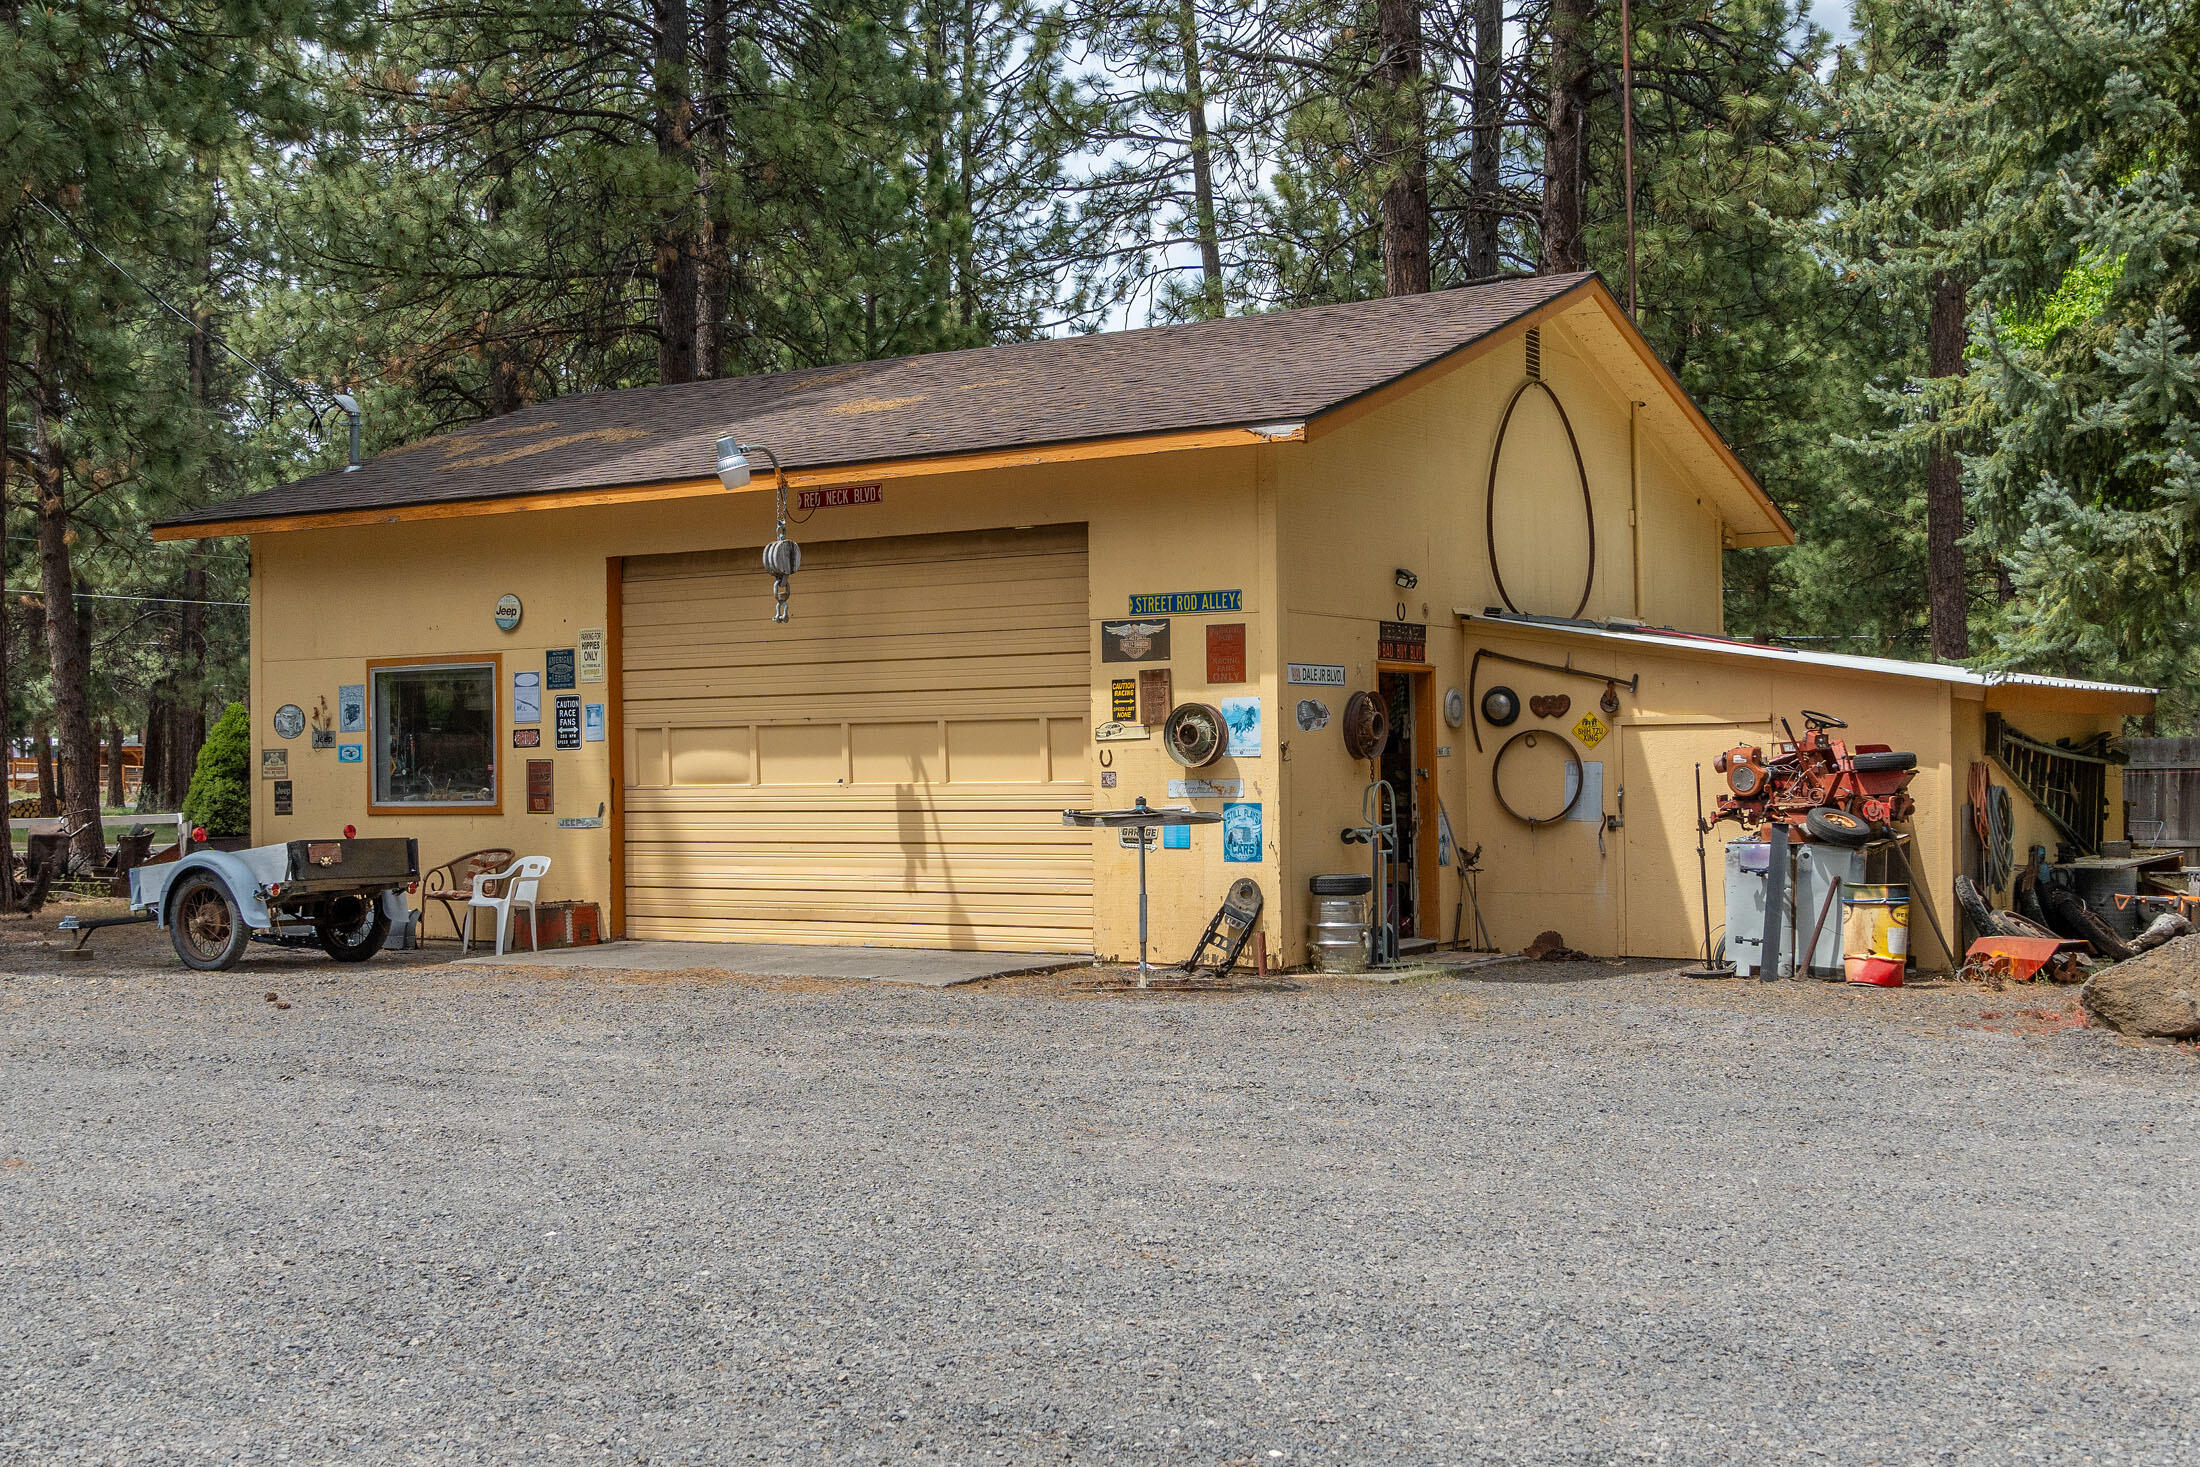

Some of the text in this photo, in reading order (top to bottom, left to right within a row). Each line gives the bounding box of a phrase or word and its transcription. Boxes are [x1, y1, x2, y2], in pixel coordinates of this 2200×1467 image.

[804, 487, 876, 508] RED NECK BLVD
[1135, 592, 1236, 613] STREET ROD ALLEY
[496, 606, 517, 618] Jeep
[582, 641, 600, 650] HIPPIES
[584, 651, 599, 661] ONLY
[1213, 672, 1240, 682] ONLY
[1302, 668, 1318, 681] DALE
[1318, 669, 1326, 682] JR
[1112, 682, 1135, 690] CAUTION
[1114, 689, 1134, 697] RACING
[556, 700, 579, 708] CAUTION
[559, 709, 577, 717] RACE
[560, 718, 577, 726] FANS
[315, 735, 333, 744] Jeep
[1583, 734, 1599, 742] XING
[1226, 809, 1241, 824] STILL
[559, 819, 582, 827] JEEP
[1121, 827, 1157, 837] GARGE
[1231, 843, 1255, 855] CARS
